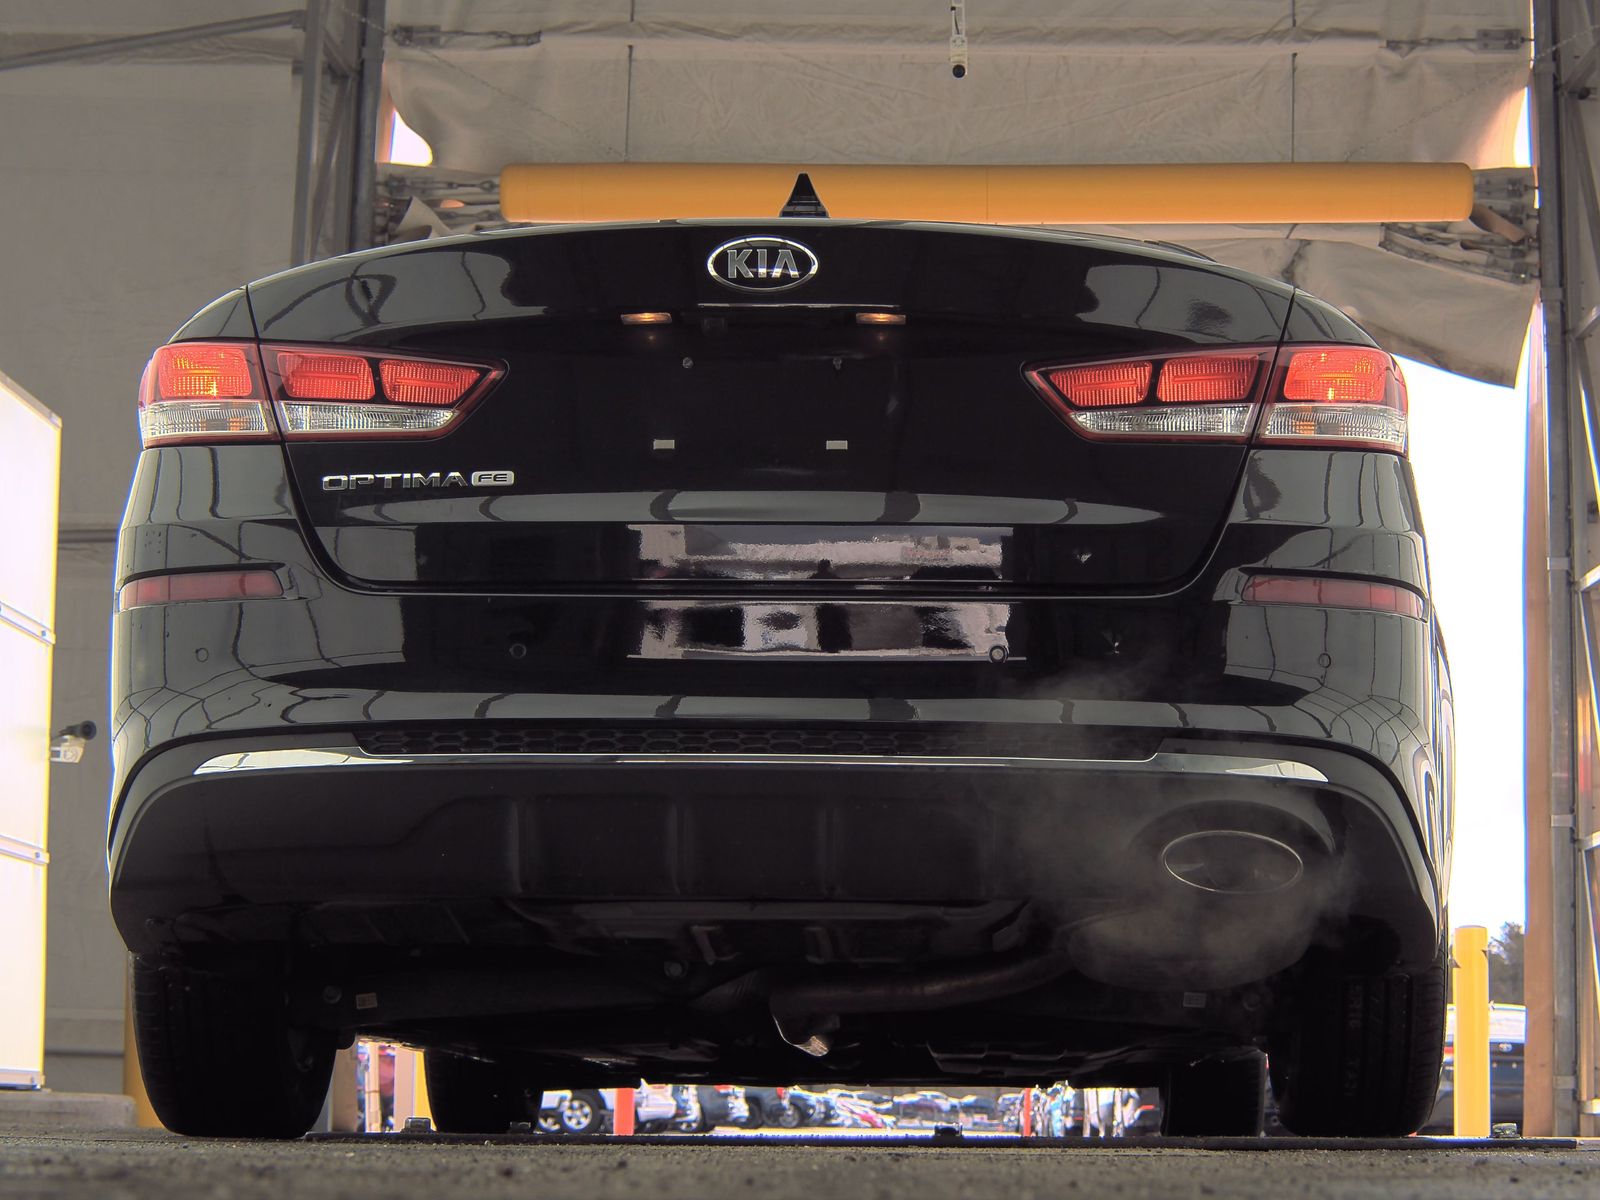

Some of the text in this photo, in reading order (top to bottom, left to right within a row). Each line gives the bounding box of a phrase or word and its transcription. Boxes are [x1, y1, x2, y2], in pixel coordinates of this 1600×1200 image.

[726, 248, 800, 279] KIA
[322, 471, 509, 491] OPTIMA FE
